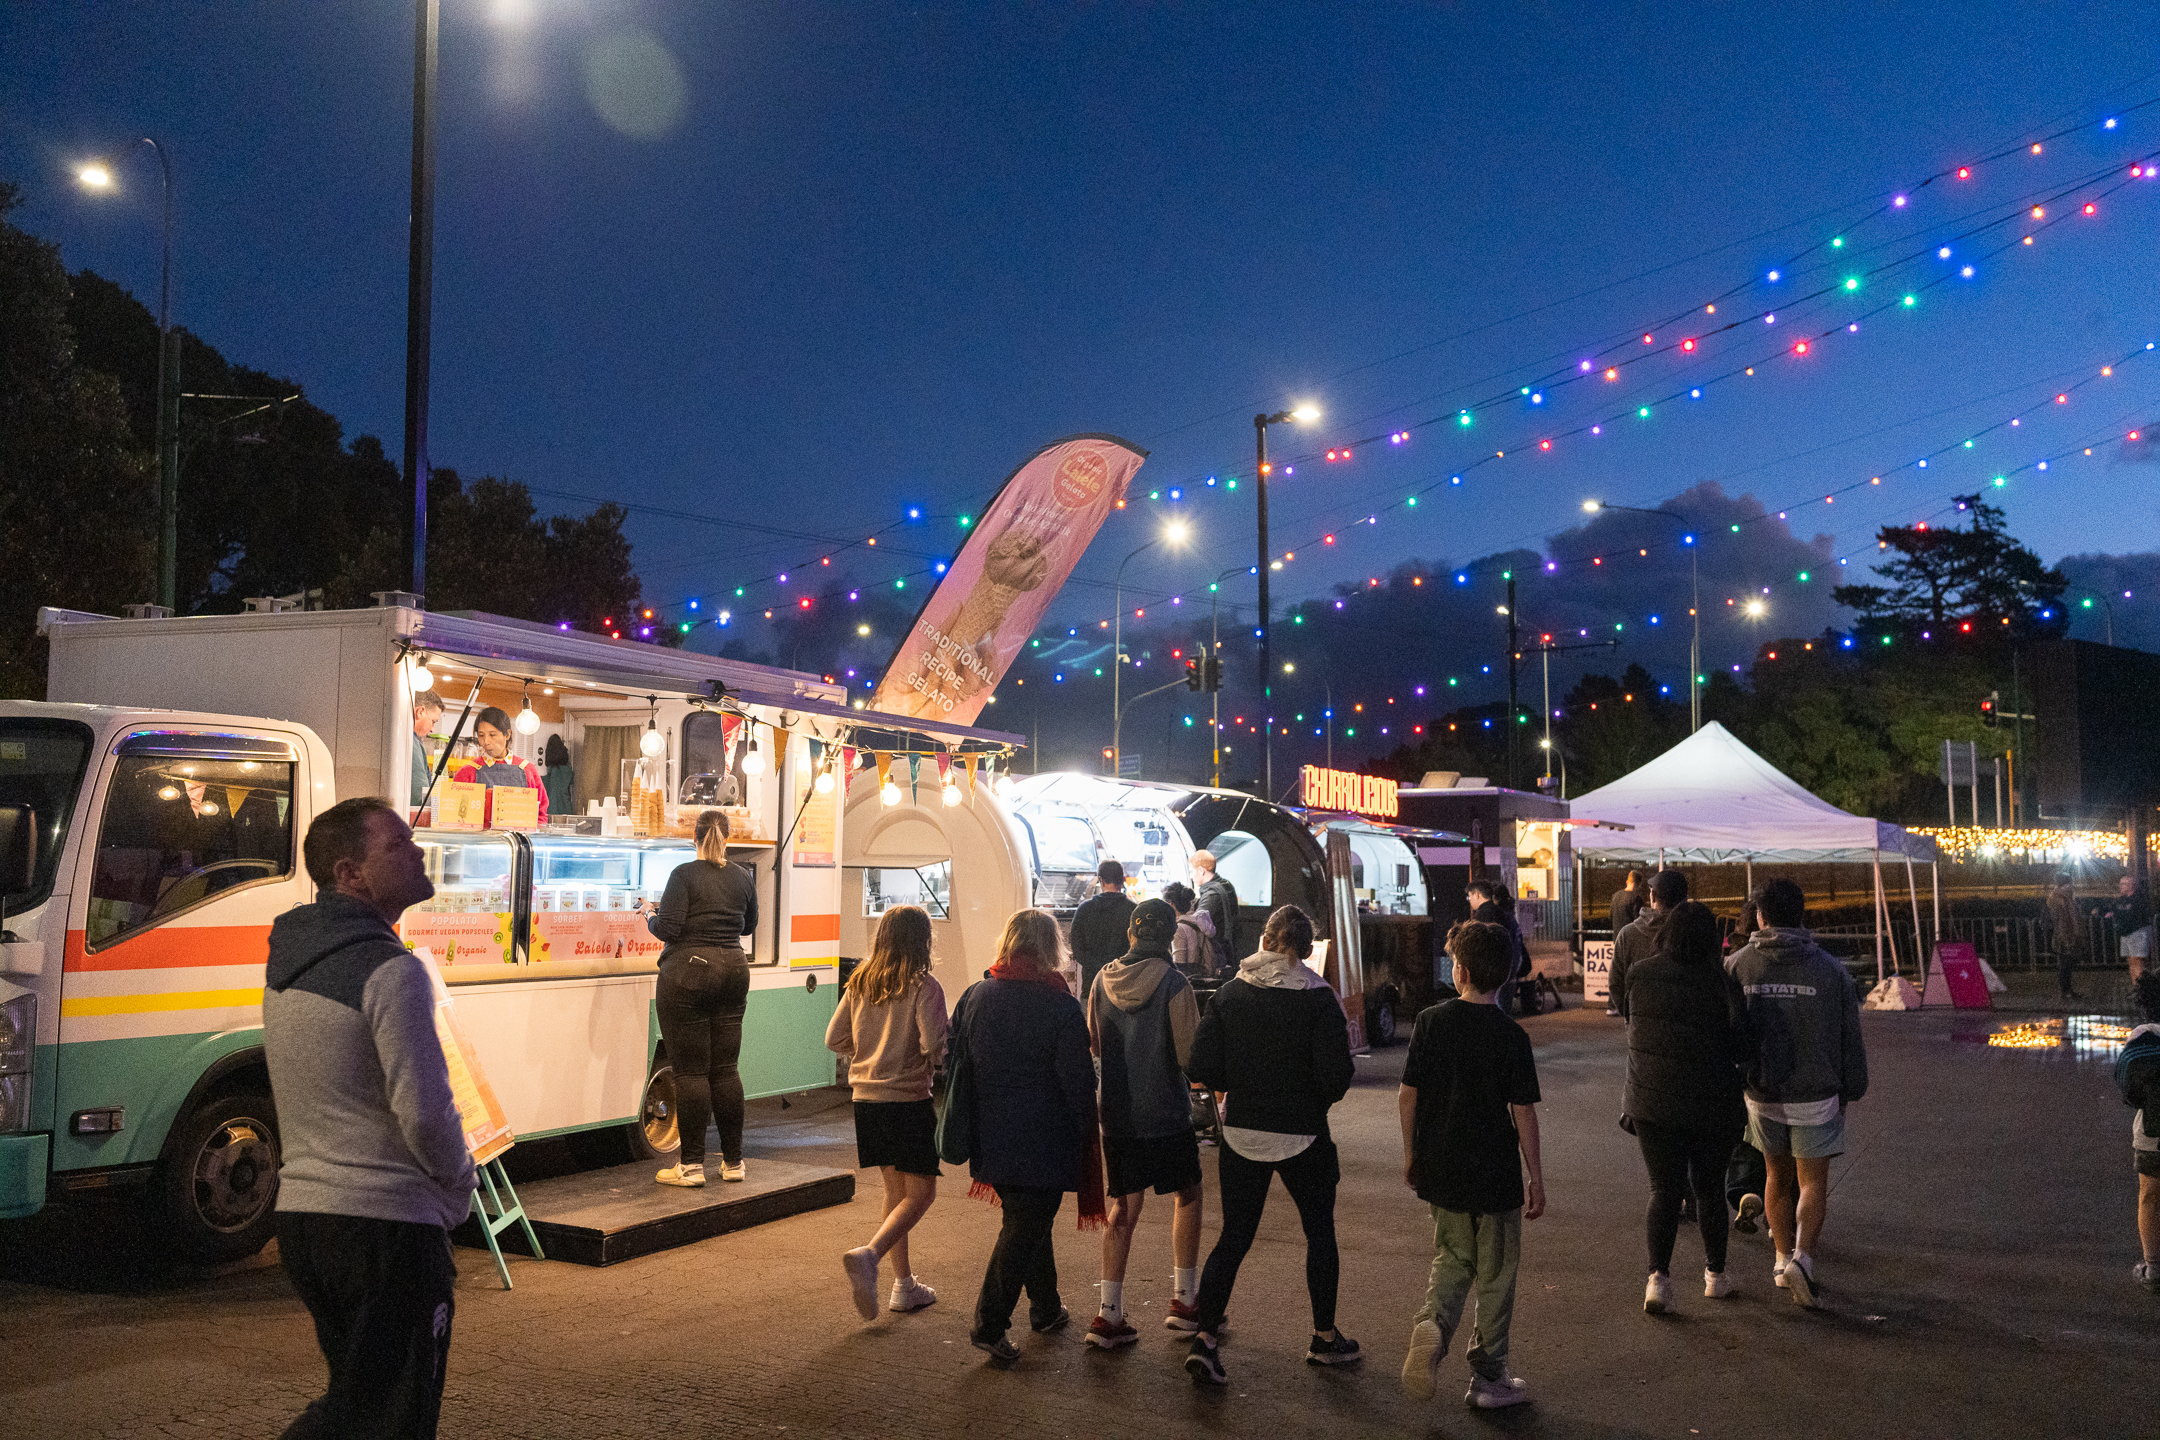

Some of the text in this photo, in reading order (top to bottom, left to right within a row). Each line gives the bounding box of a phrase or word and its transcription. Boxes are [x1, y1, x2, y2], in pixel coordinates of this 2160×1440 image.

[1077, 455, 1102, 475] Organic
[1061, 478, 1086, 499] Gelato
[919, 619, 994, 686] TRADITIONAL
[920, 651, 965, 691] RECIPE
[907, 672, 954, 712] GELATO
[1304, 764, 1399, 818] CHURROLICIOUS
[471, 800, 482, 810] $9
[431, 916, 477, 926] POPOLATO
[553, 915, 583, 924] SORBET
[603, 913, 640, 923] COCOLATO
[456, 945, 487, 957] Organic
